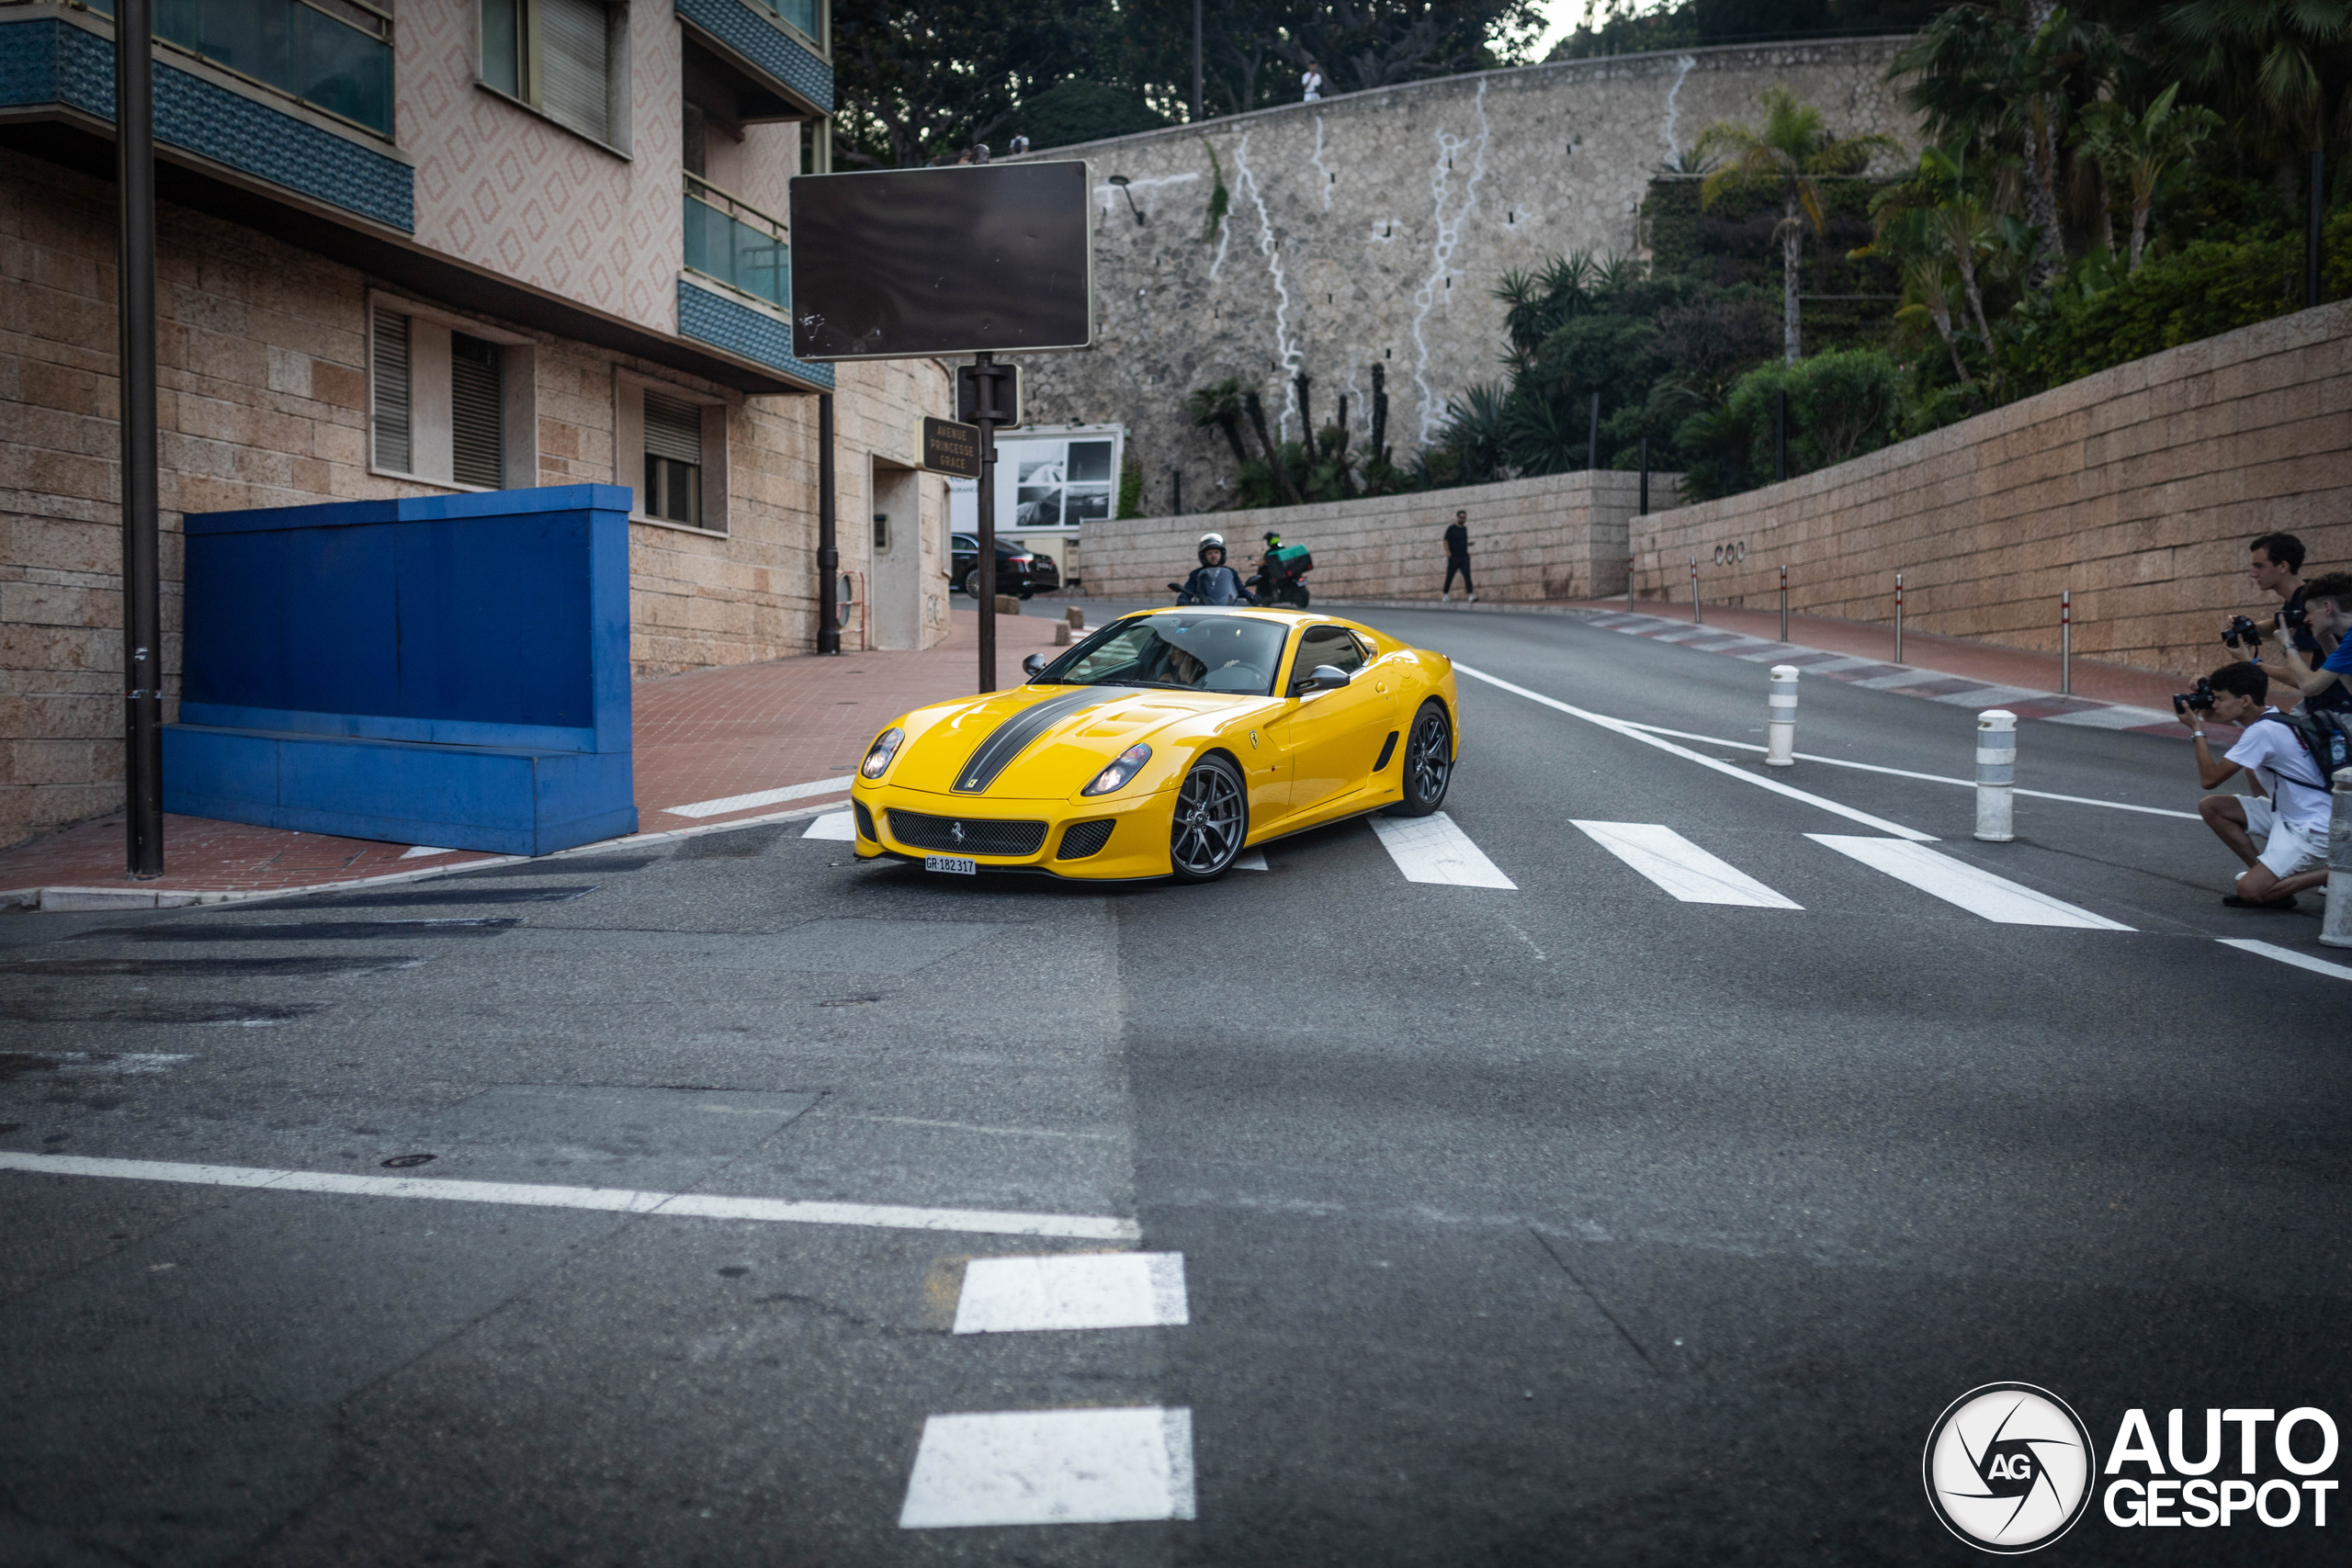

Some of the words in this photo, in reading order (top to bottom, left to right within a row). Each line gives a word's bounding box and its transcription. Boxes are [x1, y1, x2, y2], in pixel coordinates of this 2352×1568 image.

[937, 426, 967, 441] AVENUE
[931, 439, 974, 457] PRINCESSE
[940, 456, 965, 468] GRACE
[957, 860, 973, 872] 317
